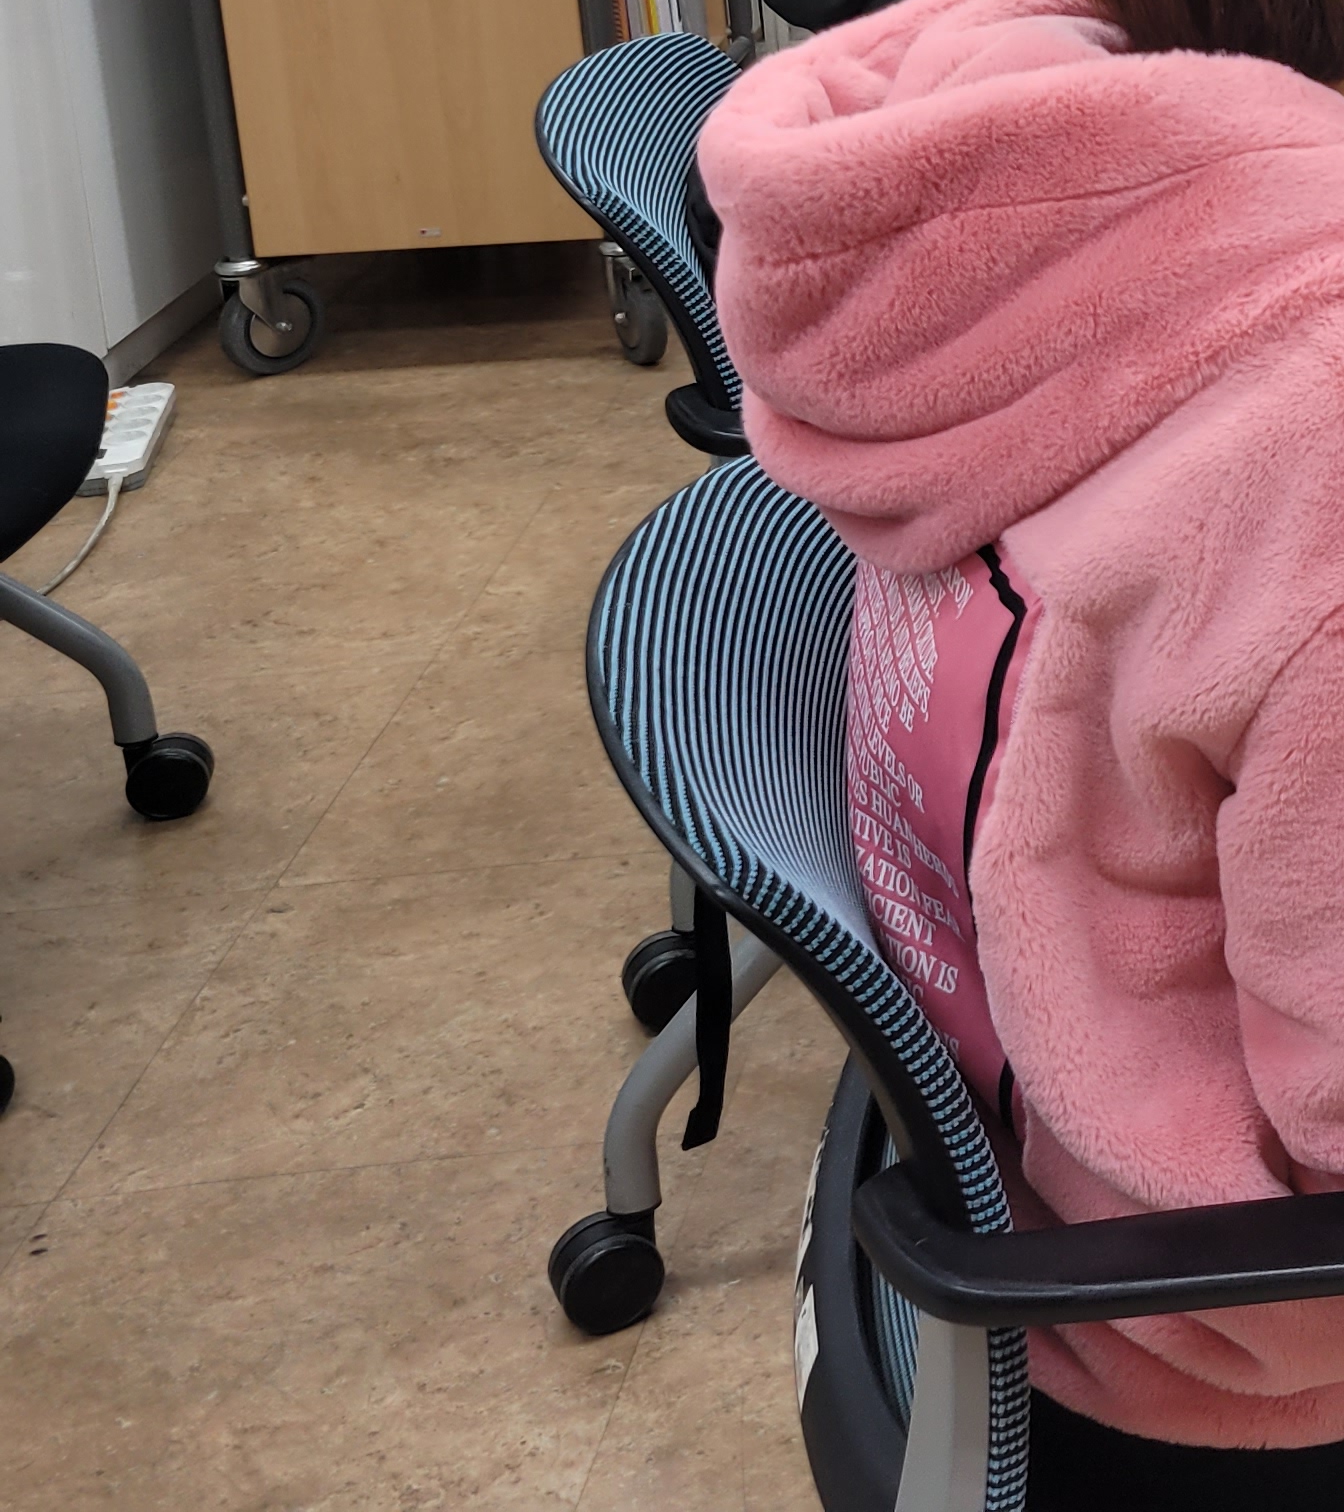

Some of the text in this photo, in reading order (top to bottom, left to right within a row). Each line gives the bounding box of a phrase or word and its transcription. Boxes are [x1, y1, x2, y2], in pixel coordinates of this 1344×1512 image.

[907, 773, 925, 814] OR
[896, 839, 912, 869] IS
[935, 960, 960, 995] IS
